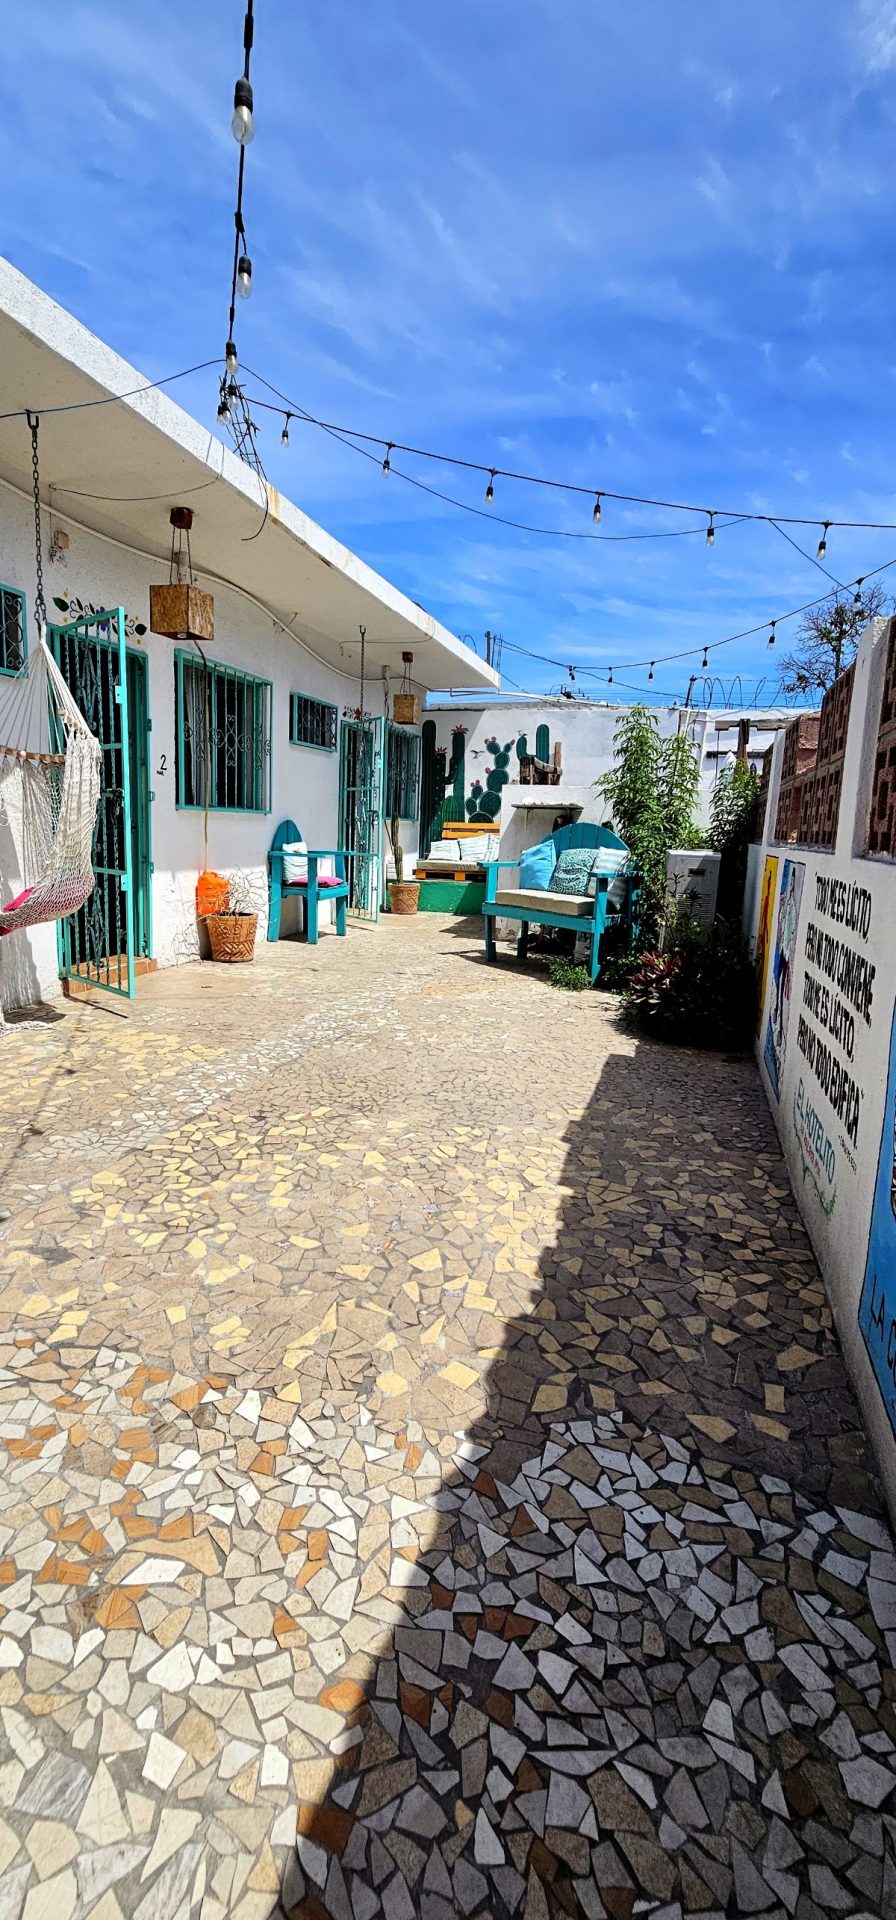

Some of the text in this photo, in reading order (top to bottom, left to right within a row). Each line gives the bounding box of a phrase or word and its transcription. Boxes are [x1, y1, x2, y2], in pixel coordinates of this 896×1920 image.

[160, 753, 168, 771] 2
[827, 878, 839, 920] ME
[835, 880, 847, 925] ES
[845, 879, 872, 945] LÍCITO,
[804, 920, 818, 963] PERO
[814, 929, 825, 970] NO
[821, 932, 840, 983] TODO
[802, 970, 855, 1063] TODO ME ES LÍCITO,
[796, 1012, 809, 1058] PERO
[806, 1026, 816, 1070] NO
[814, 1037, 831, 1097] TODO
[796, 1076, 805, 1121] EL
[805, 1096, 836, 1184] HOTELITO
[869, 1273, 885, 1342] LA
